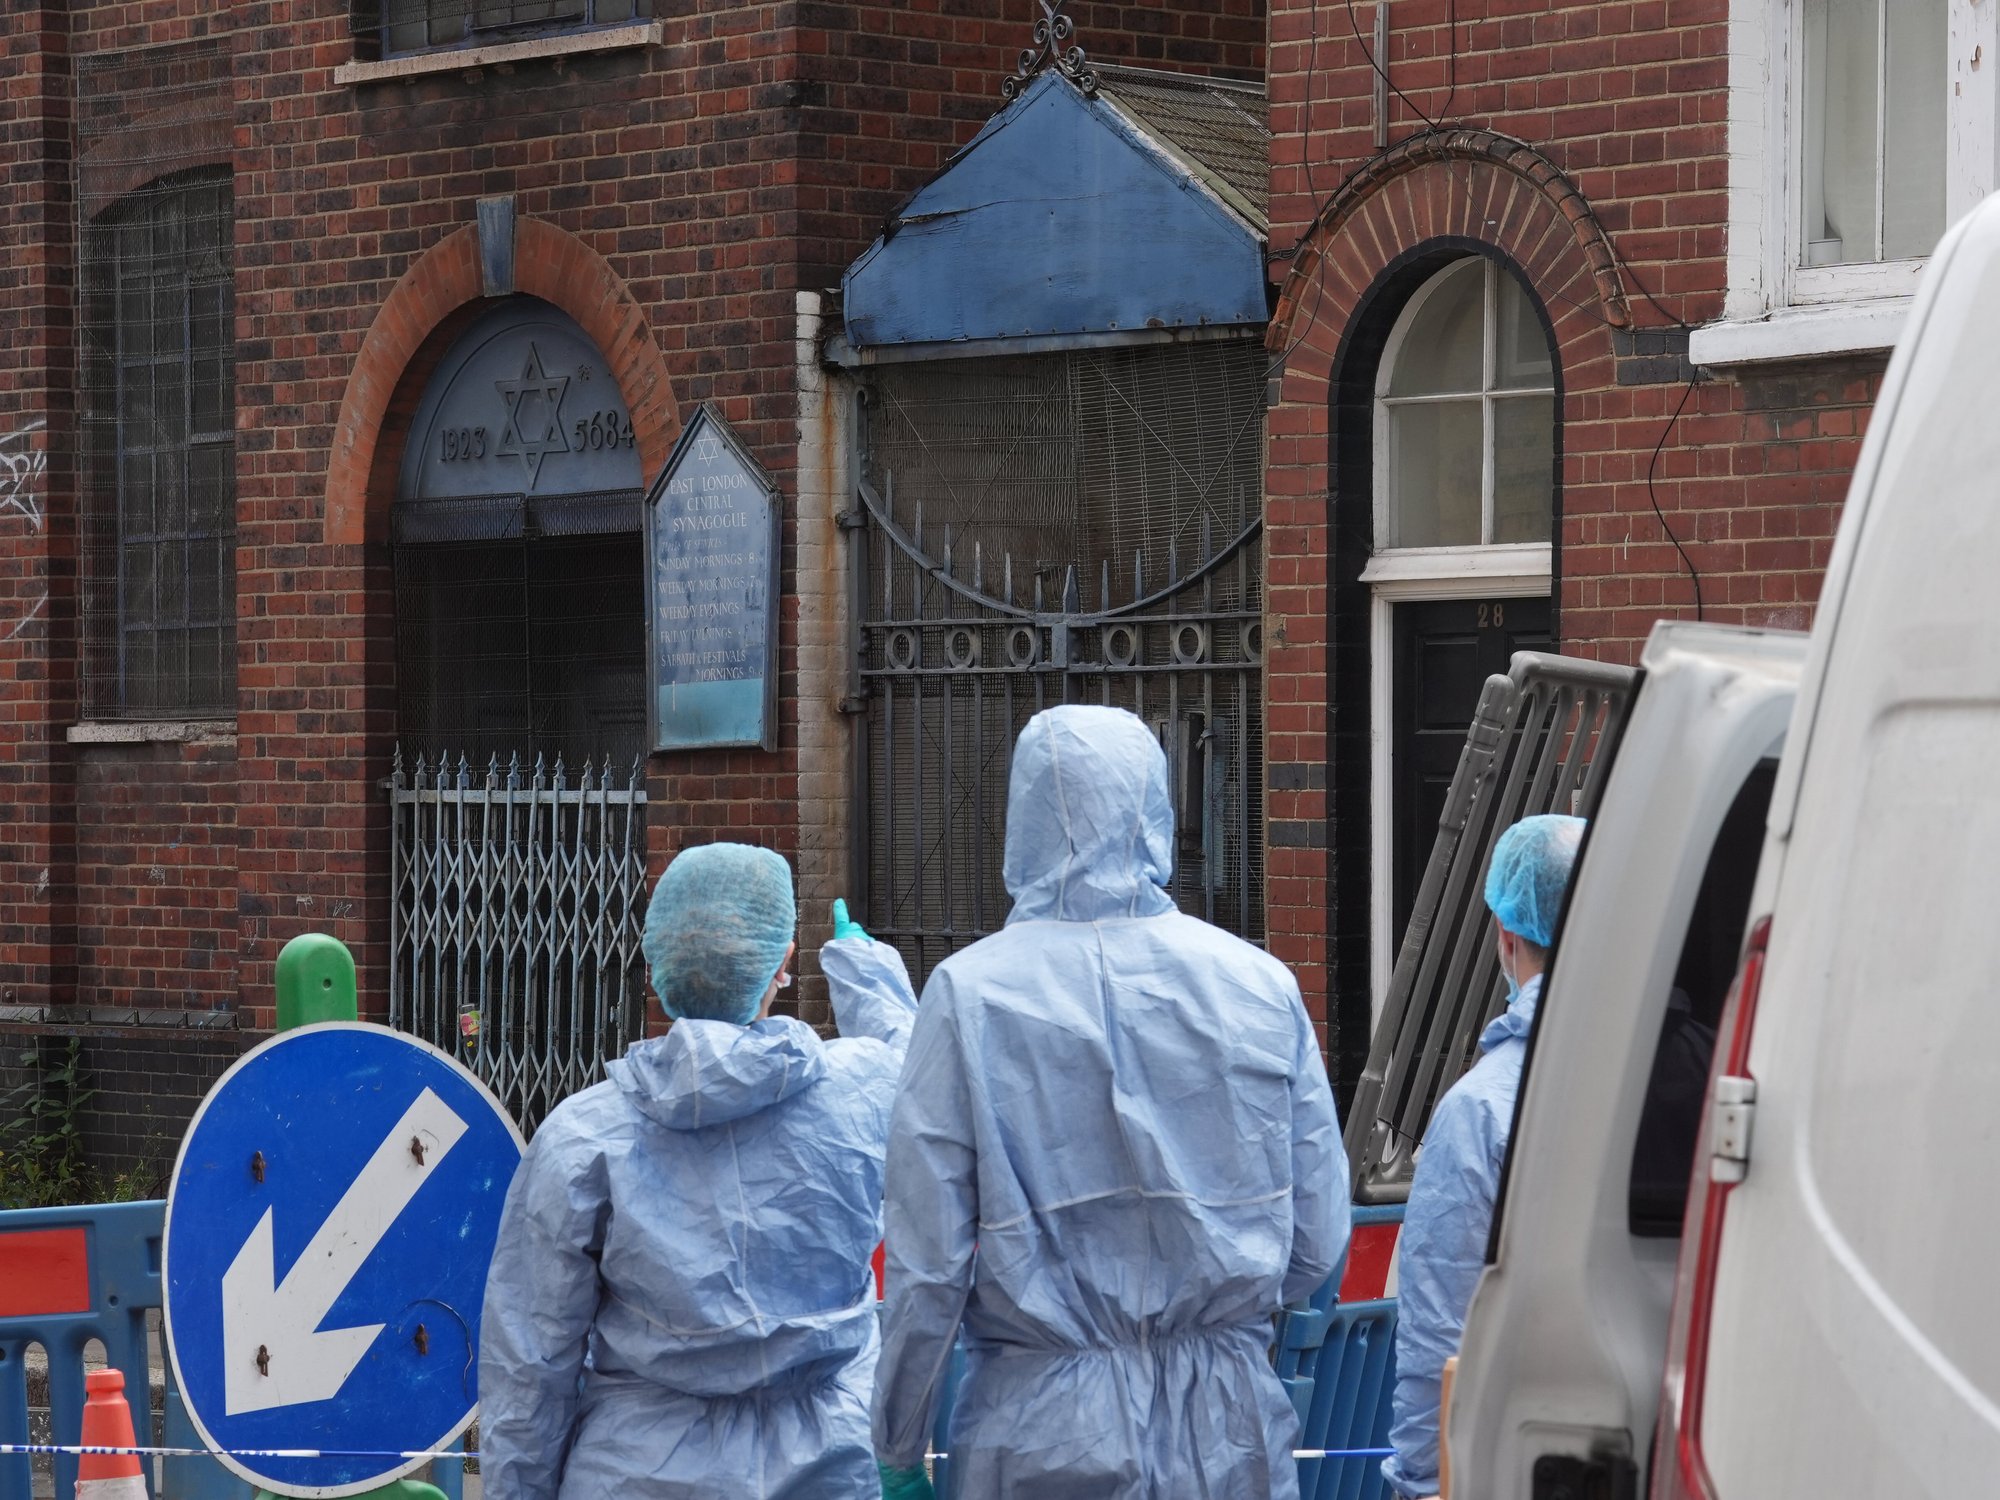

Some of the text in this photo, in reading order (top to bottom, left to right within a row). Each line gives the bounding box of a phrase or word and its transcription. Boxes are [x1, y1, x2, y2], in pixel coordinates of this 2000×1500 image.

[574, 409, 635, 452] 5684
[439, 426, 488, 463] 1923
[670, 473, 747, 494] EAST LONDON
[686, 494, 733, 511] CENTRAL
[673, 512, 748, 532] SYNAGOGUE
[658, 557, 690, 570] SUNDAY
[694, 552, 743, 568] MORNINGS
[699, 576, 745, 592] MORNINGS
[659, 602, 740, 619] WEEKDAY EVENINGS
[1477, 603, 1504, 628] 28
[660, 628, 689, 644] FRIDAY
[703, 649, 746, 665] FESTIVALS
[695, 666, 744, 682] MORNINGS
